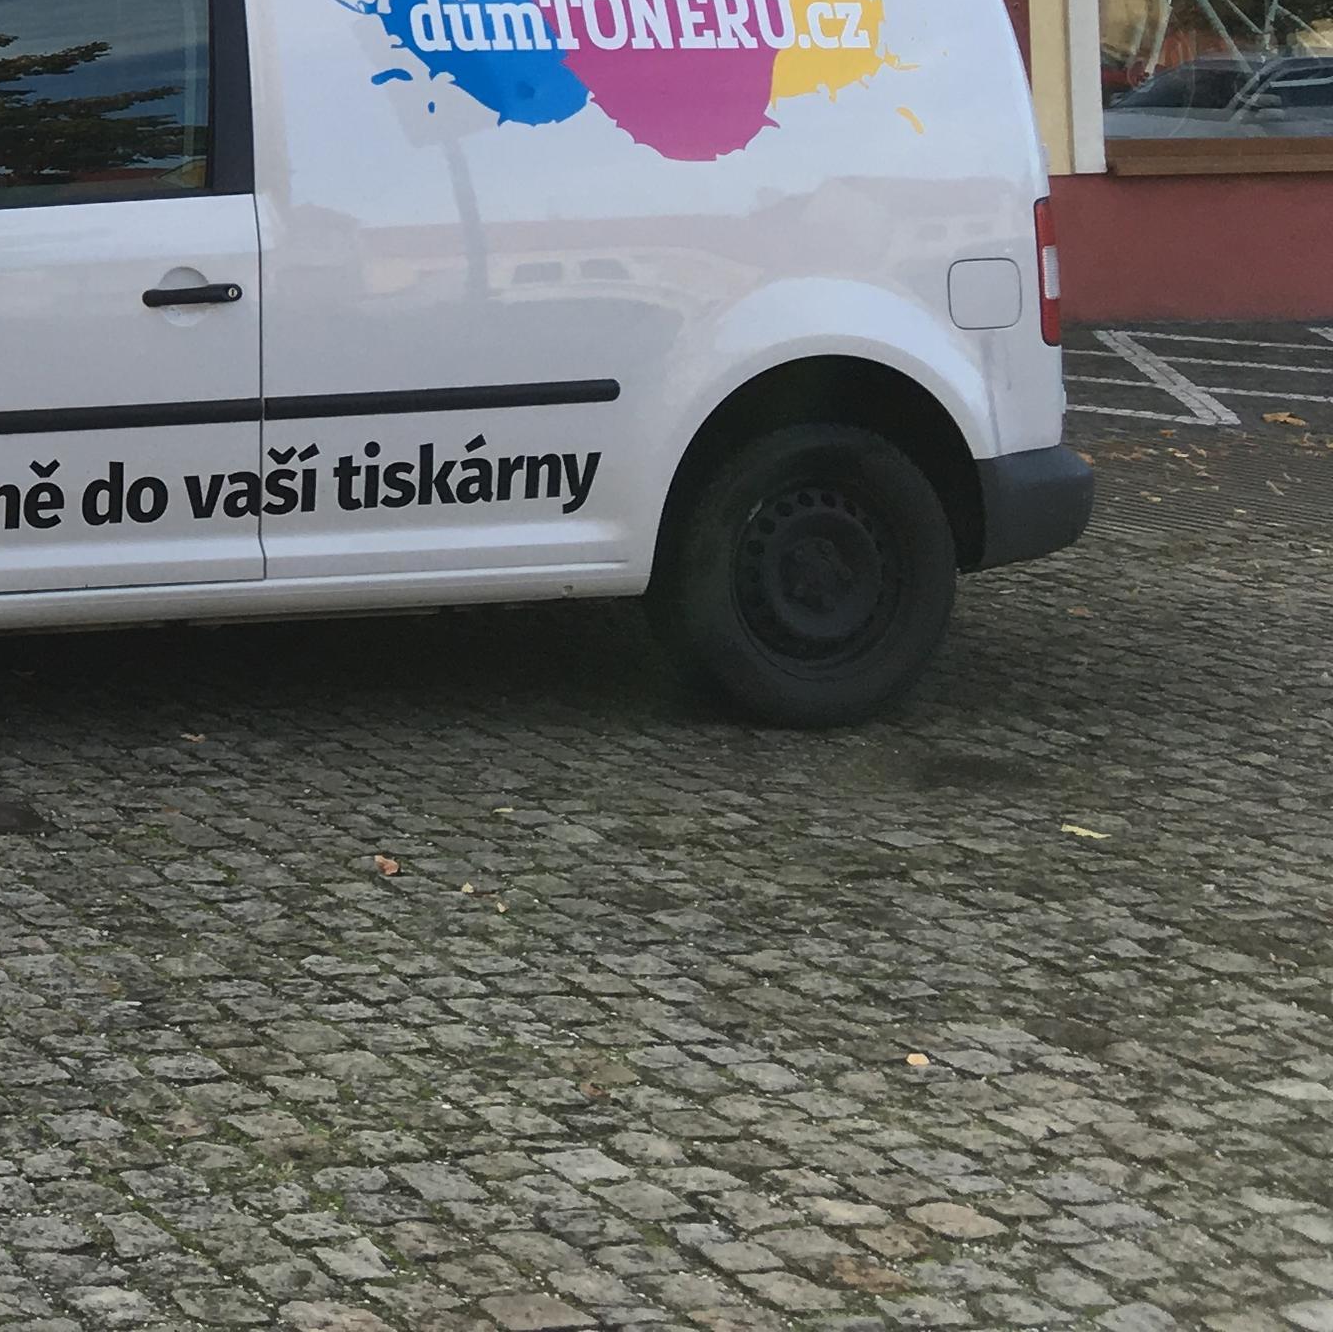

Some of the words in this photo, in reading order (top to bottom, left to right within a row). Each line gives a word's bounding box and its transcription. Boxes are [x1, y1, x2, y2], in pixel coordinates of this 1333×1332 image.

[81, 460, 169, 527] do
[182, 441, 321, 520] vaší
[332, 433, 603, 515] tiskárny
